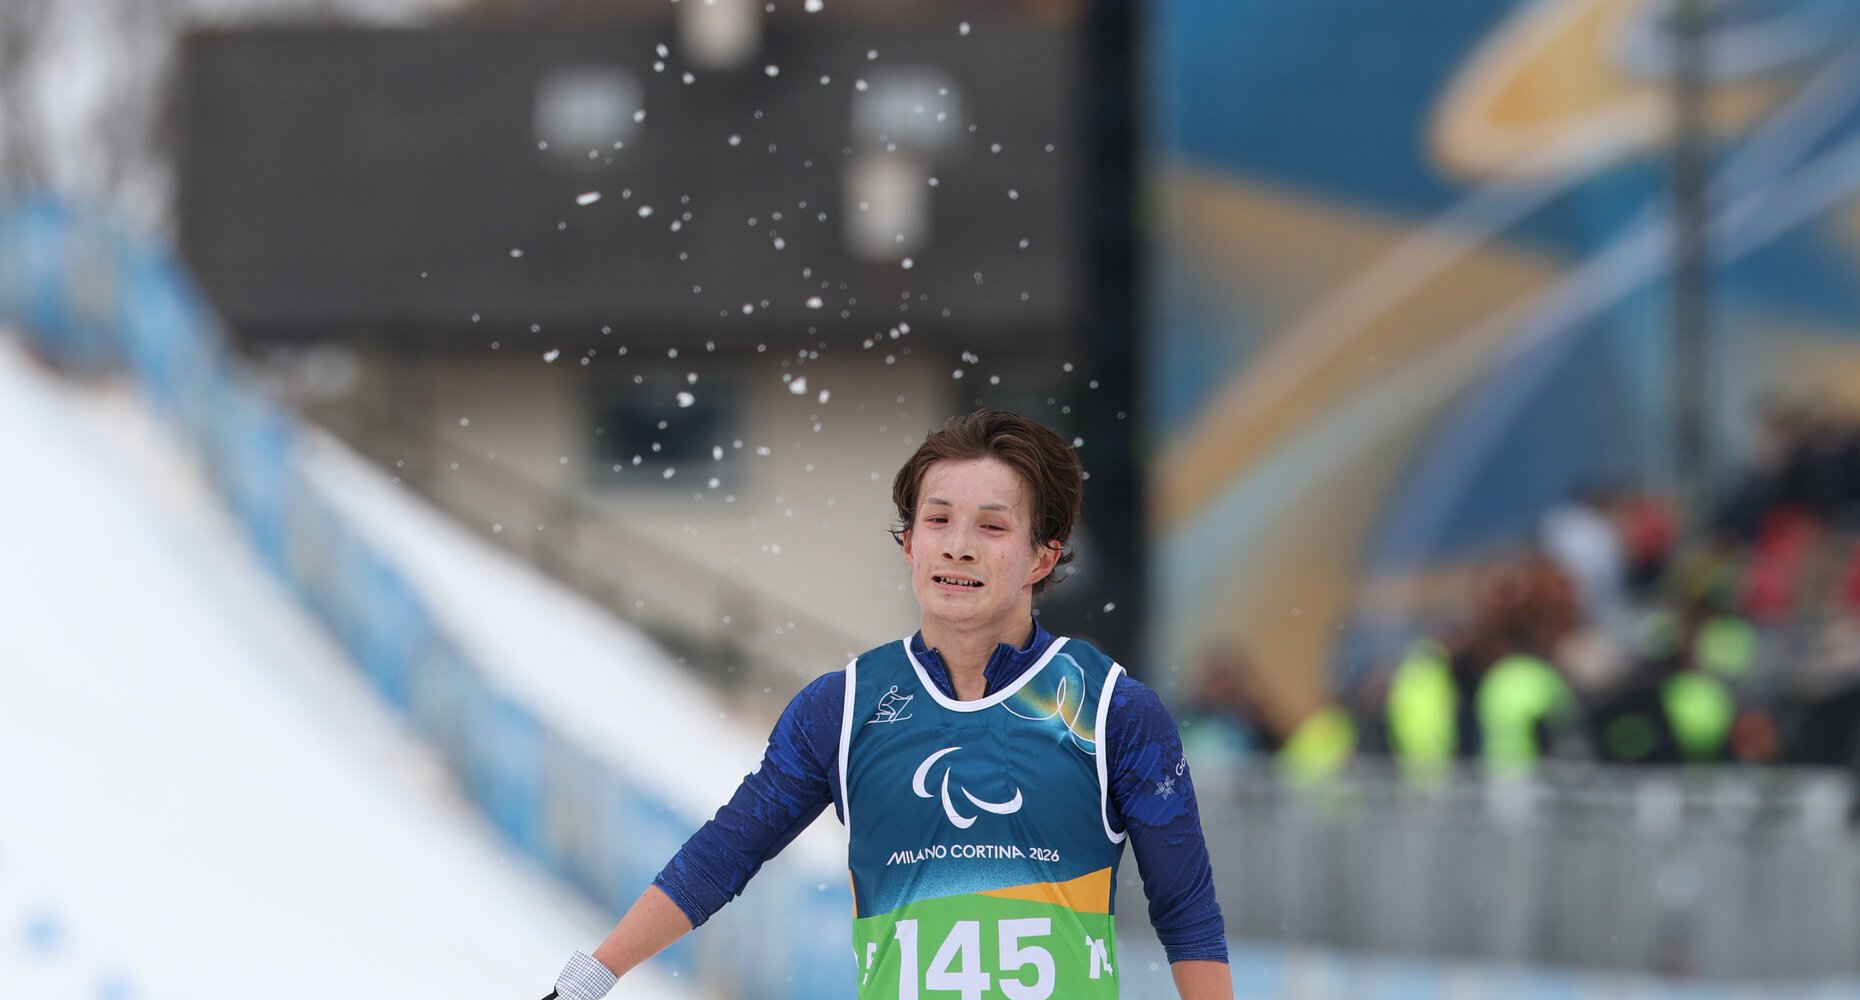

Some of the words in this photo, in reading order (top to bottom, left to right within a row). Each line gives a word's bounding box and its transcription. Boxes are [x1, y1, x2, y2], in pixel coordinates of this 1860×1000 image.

[886, 845, 947, 866] MILANO
[950, 844, 1026, 859] CORTINA
[1029, 847, 1060, 863] 2026
